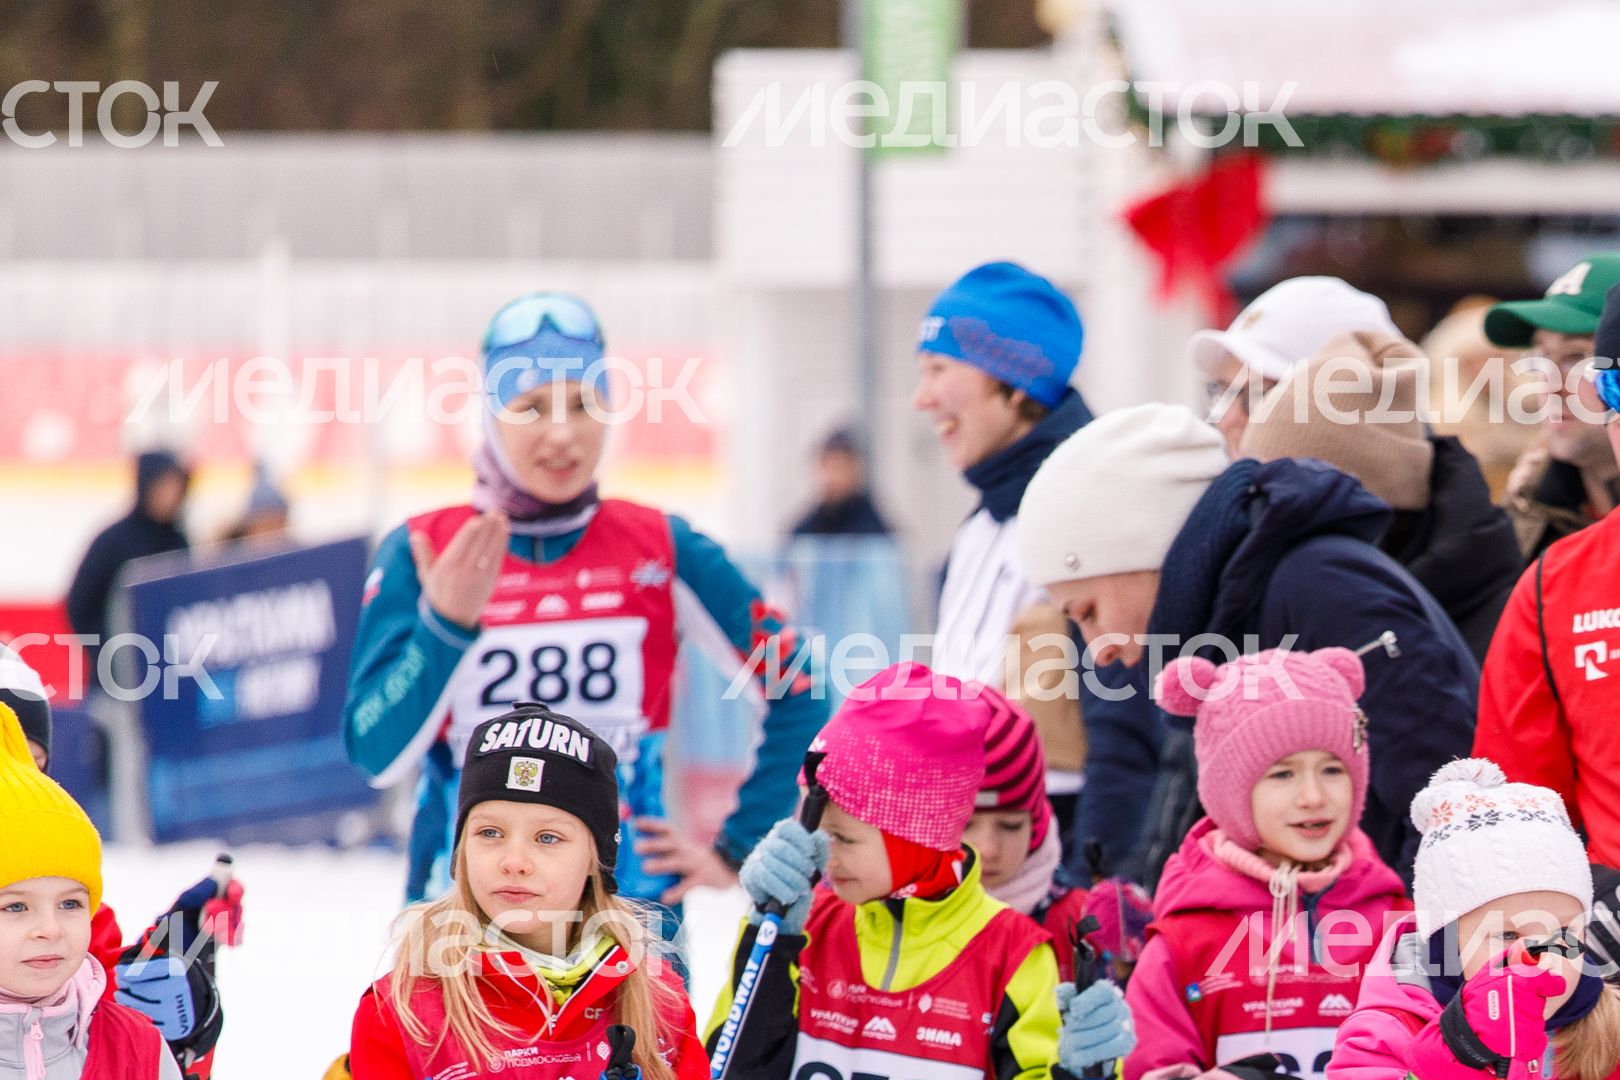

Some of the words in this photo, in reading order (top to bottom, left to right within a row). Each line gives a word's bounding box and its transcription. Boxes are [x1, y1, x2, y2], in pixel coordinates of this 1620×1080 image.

[480, 641, 618, 707] 288
[479, 716, 592, 765] SATURN
[711, 957, 761, 1071] NORDWAY
[916, 1026, 963, 1046] ЗИМА
